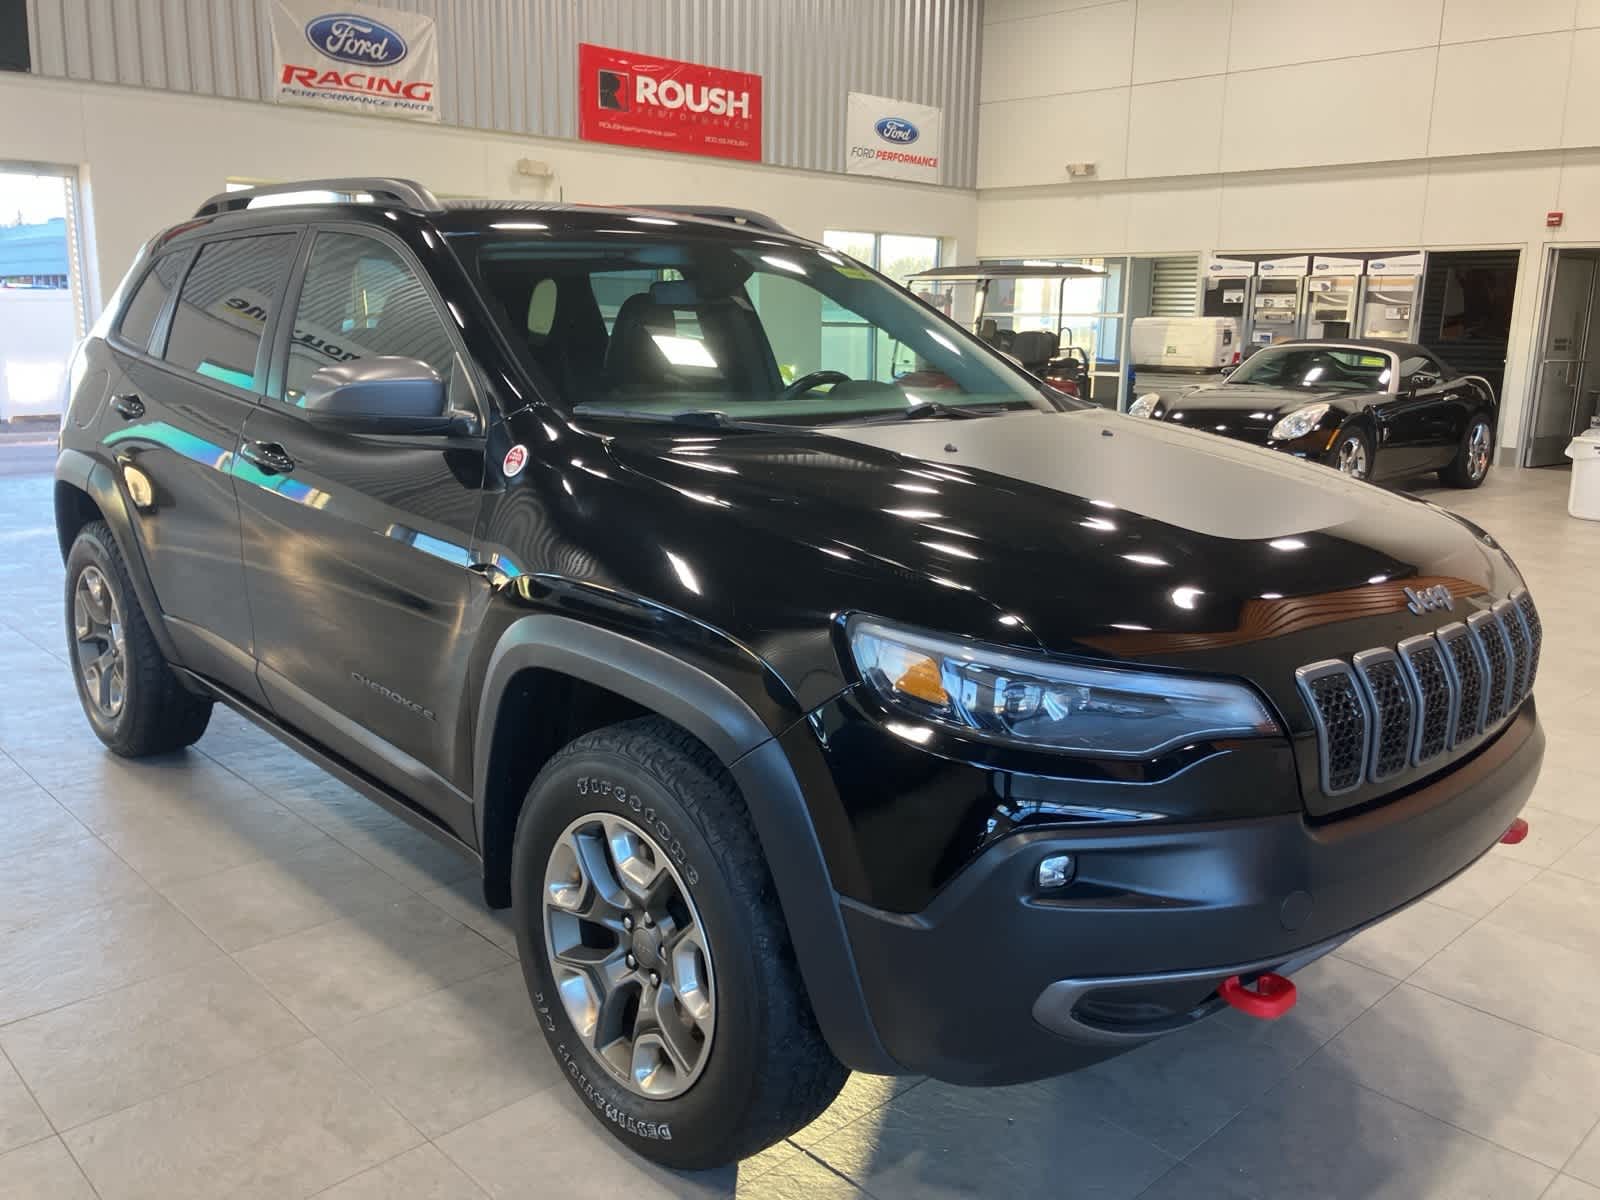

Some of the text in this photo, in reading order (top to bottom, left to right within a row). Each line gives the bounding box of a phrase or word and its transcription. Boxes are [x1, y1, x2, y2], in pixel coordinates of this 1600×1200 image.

[326, 20, 388, 60] Ford
[281, 63, 433, 102] RACING
[281, 87, 434, 112] PERFORMANCE PARTS
[635, 75, 750, 119] ROUSH
[883, 121, 912, 140] Ford
[850, 146, 939, 168] FORD PERFORMANCE
[1403, 584, 1454, 616] Jeep
[351, 671, 437, 722] CHEROKEE
[558, 1043, 672, 1140] DESTINATION
